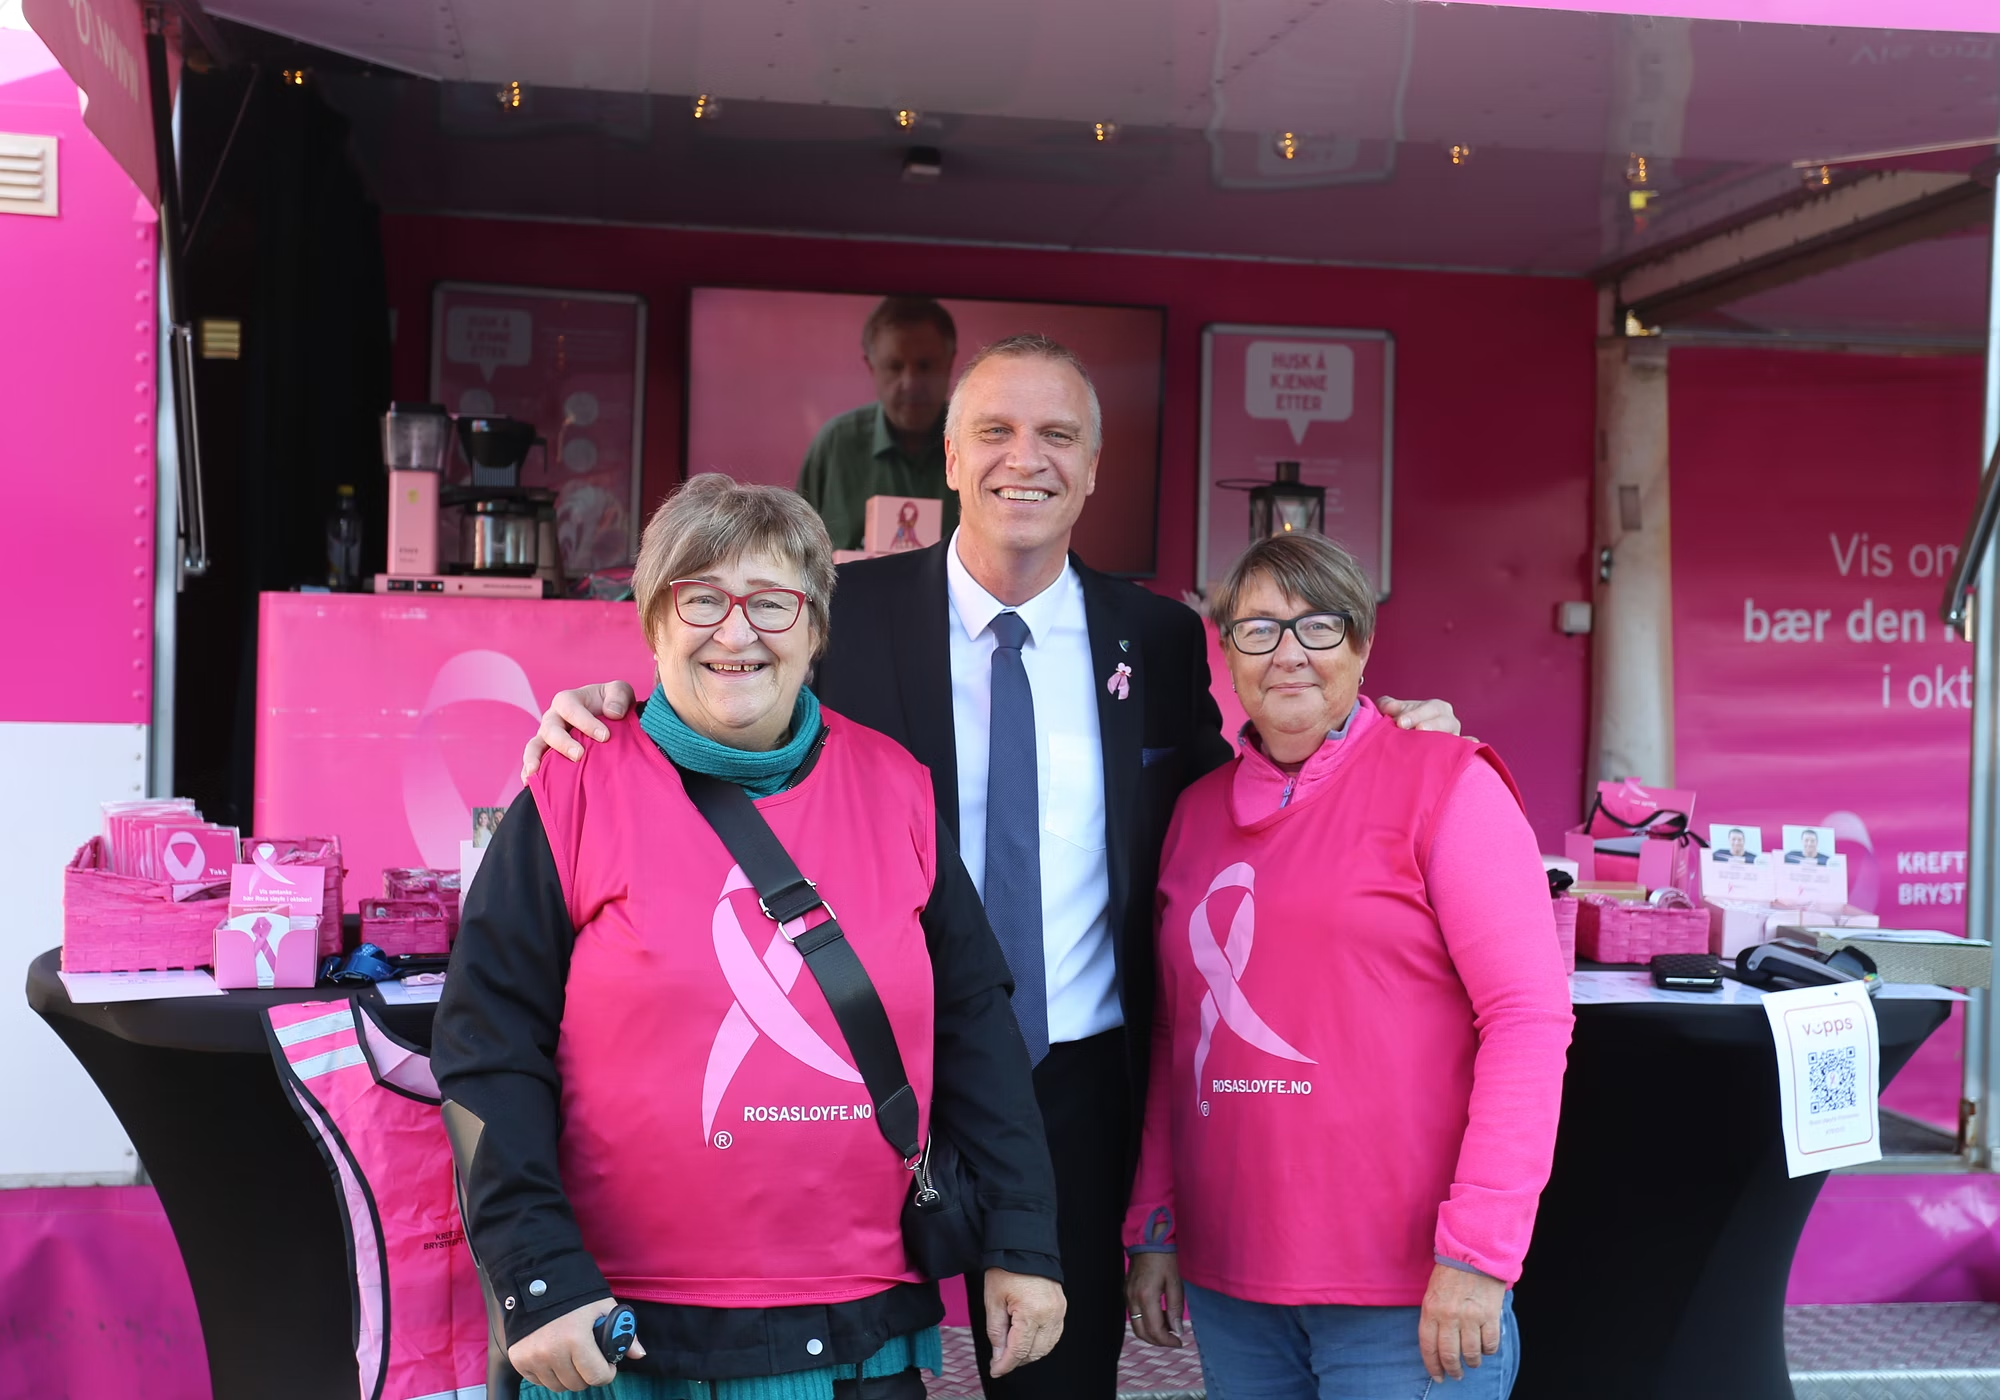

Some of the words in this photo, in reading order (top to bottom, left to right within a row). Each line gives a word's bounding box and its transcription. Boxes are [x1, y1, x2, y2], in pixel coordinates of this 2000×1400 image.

[1271, 352, 1312, 369] HUSK
[1315, 350, 1327, 370] Å
[1270, 373, 1328, 391] KJENNE
[1276, 393, 1321, 411] ETTER
[1829, 532, 1893, 578] Vis
[1743, 597, 1831, 643] bær
[1846, 597, 1926, 643] den
[1882, 663, 1891, 708] i
[1212, 1079, 1312, 1095] ROSASLOYFE.NO
[743, 1104, 872, 1122] ROSASLOYFE.NO
